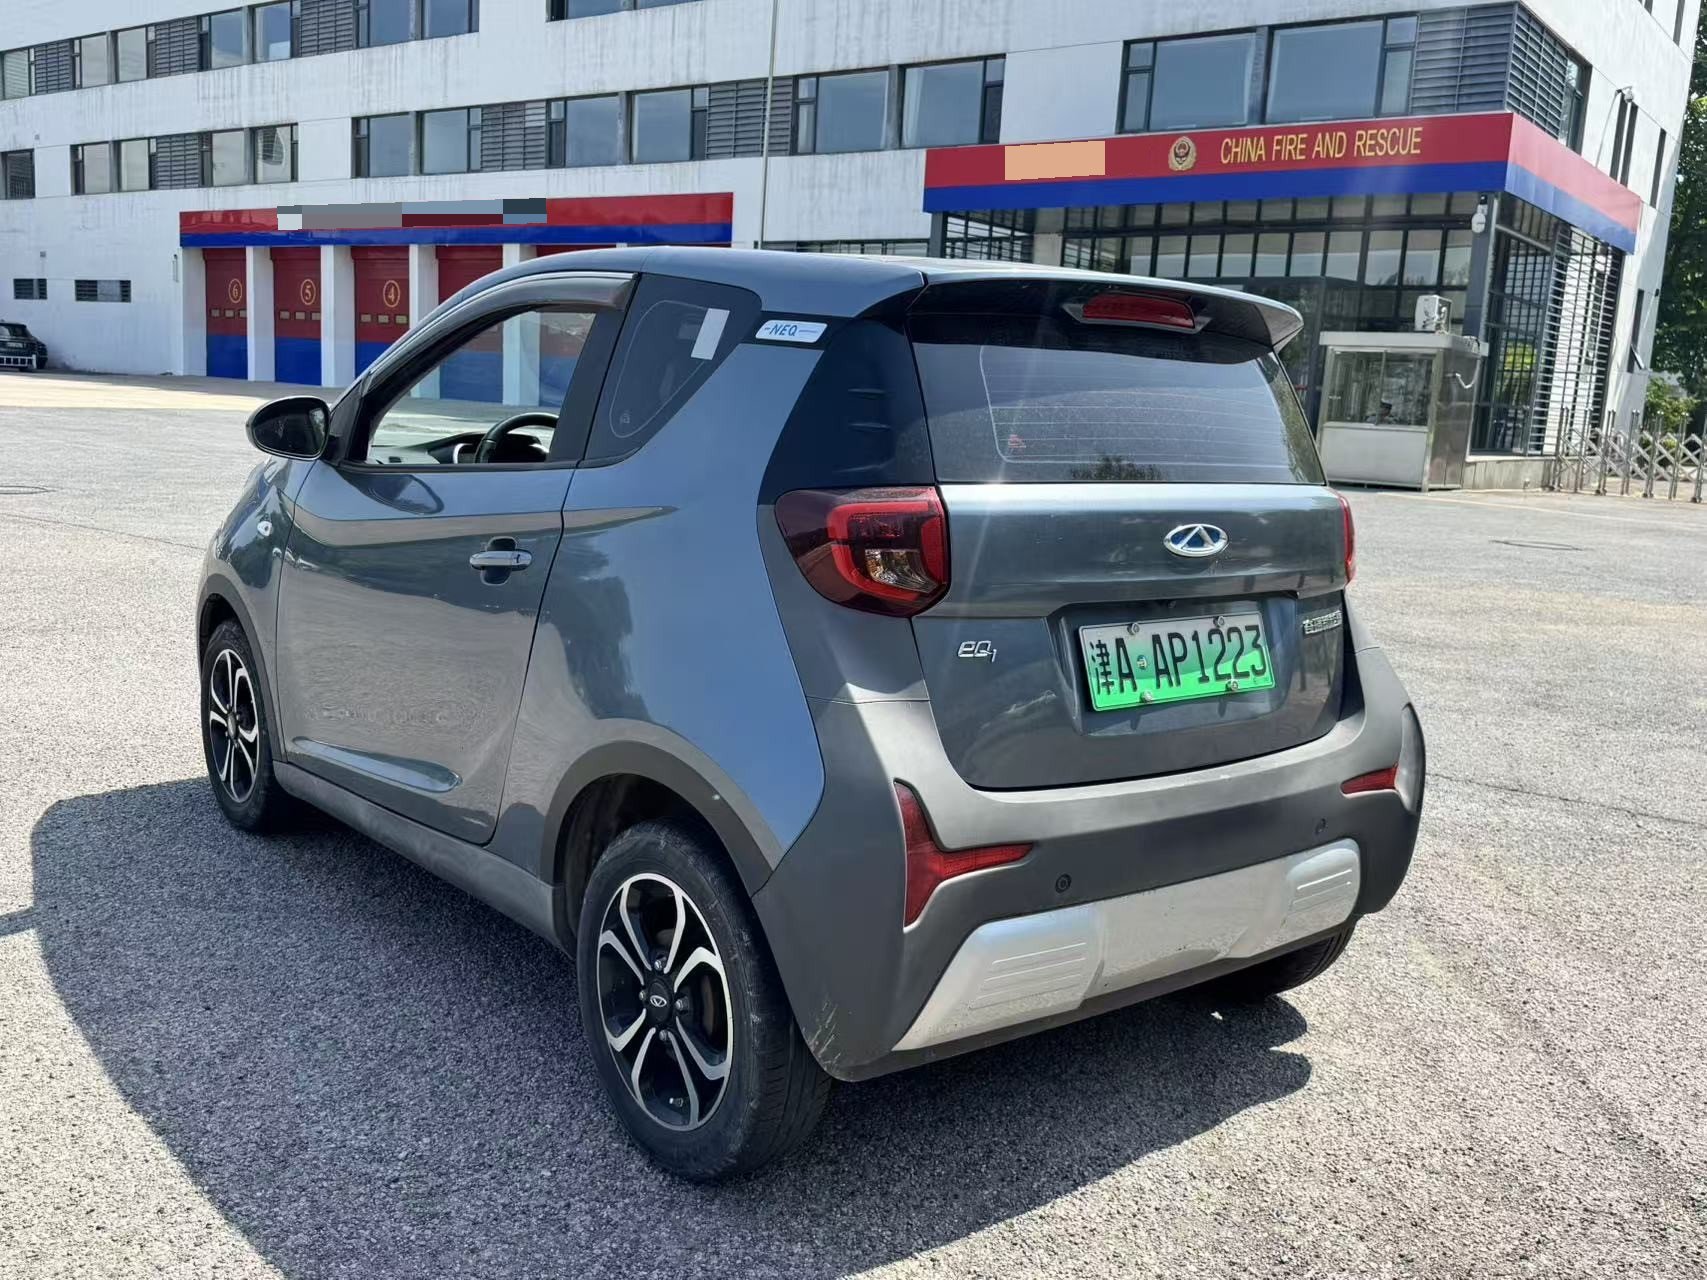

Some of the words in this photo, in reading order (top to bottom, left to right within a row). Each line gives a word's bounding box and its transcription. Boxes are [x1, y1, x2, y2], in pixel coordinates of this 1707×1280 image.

[1220, 136, 1266, 164] CHINA
[1272, 133, 1308, 161] FIRE
[1312, 131, 1347, 159] AND
[1353, 127, 1423, 157] RESCUE
